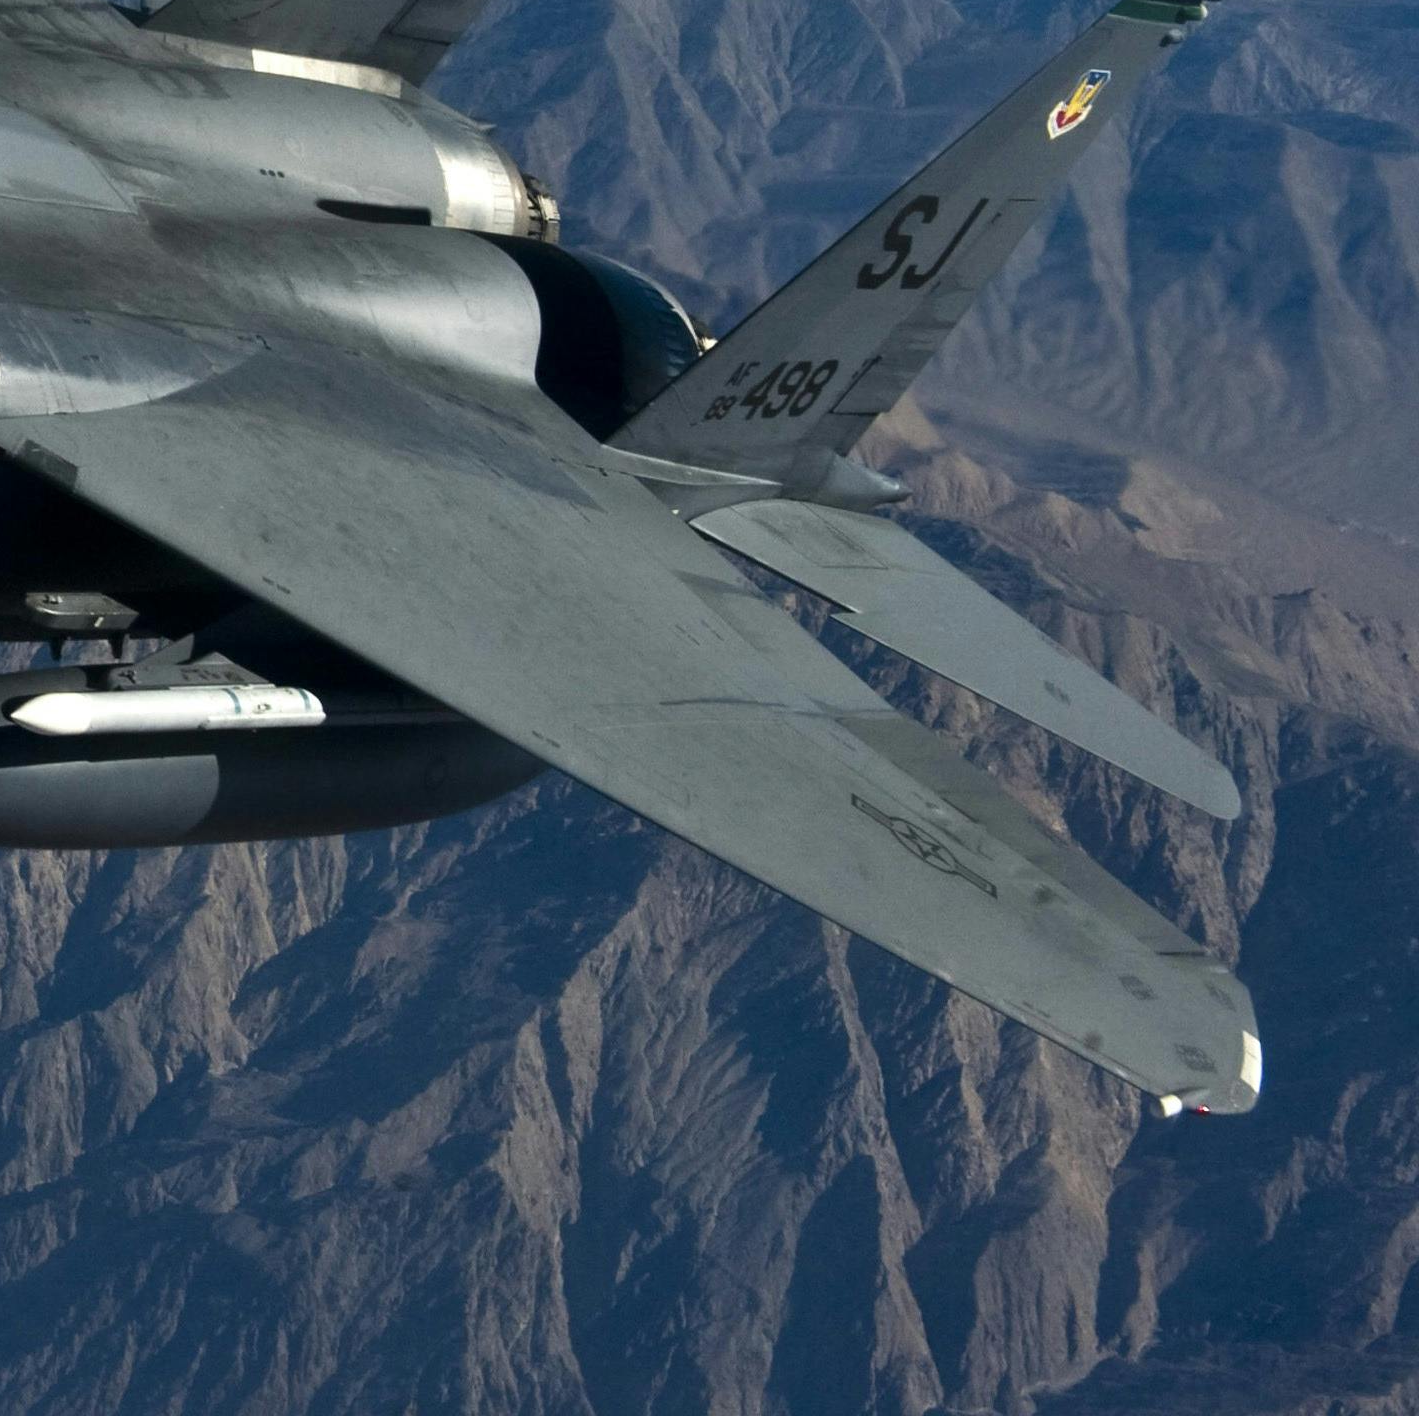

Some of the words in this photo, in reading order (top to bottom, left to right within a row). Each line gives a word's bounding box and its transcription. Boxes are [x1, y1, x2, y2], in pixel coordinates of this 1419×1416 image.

[856, 195, 989, 289] SJ
[725, 362, 761, 386] AF
[740, 359, 839, 420] 498
